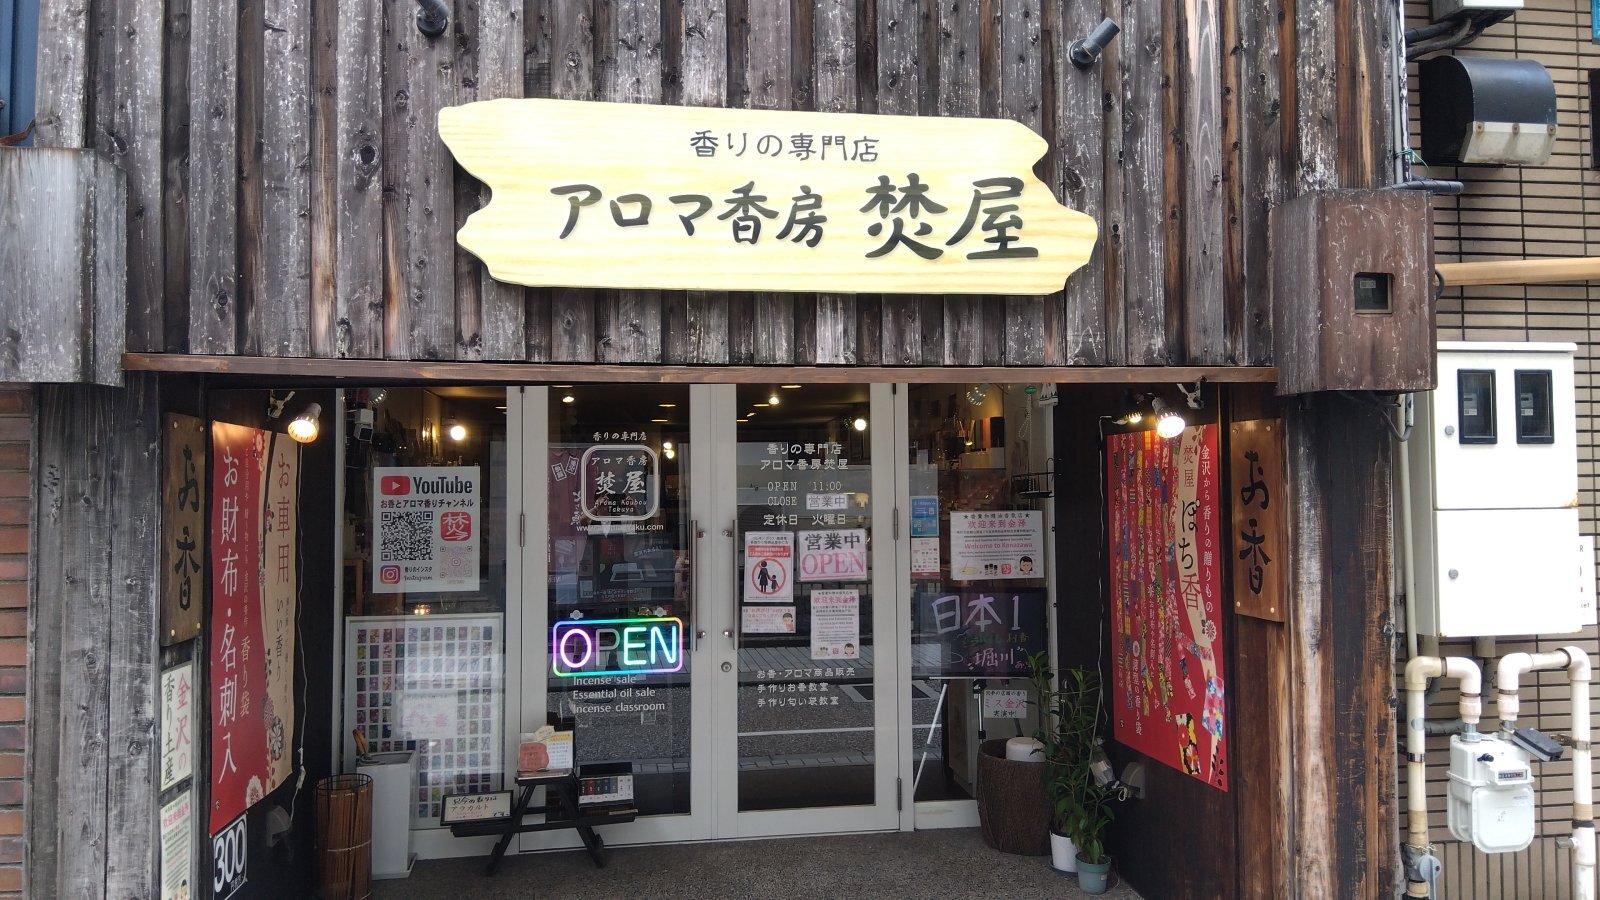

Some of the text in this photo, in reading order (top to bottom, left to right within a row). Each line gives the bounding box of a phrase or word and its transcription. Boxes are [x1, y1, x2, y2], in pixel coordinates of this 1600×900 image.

[690, 131, 880, 163] 香りの専門店
[550, 173, 1039, 260] アロマ香房 焚屋
[592, 432, 647, 441] 香りの専門店
[767, 443, 842, 455] 香りの専門店
[591, 455, 648, 466] アロマ香房
[760, 458, 848, 471] アロマ香房焚屋
[1182, 445, 1195, 488] 焚屋
[413, 476, 473, 494] YouTube
[595, 470, 646, 495] 焚屋
[767, 481, 842, 491] OPEN 11:00
[380, 499, 474, 509] お香とアロマ香りチャンネル
[767, 496, 798, 506] CLOSE
[808, 496, 846, 507] 営業中
[276, 452, 291, 585] お車用
[763, 513, 846, 526] 定休日 火曜日
[1239, 450, 1272, 595] お香
[174, 444, 201, 611] お香
[1201, 445, 1214, 613] 金沢から香りの贈りもの
[805, 532, 860, 551] 営業中
[1178, 500, 1201, 611] ぽち香
[801, 552, 866, 575] OPEN
[404, 574, 433, 582] Instagram
[560, 625, 677, 668] OPEN
[573, 674, 637, 686] Incense sale
[756, 668, 856, 679] お香・アロマ商品販売
[573, 687, 656, 700] Essential oil sale
[757, 682, 829, 693] 手作りお香教室
[573, 702, 666, 714] Incense classroom
[175, 672, 192, 771] 金沢の
[214, 821, 246, 893] 300
